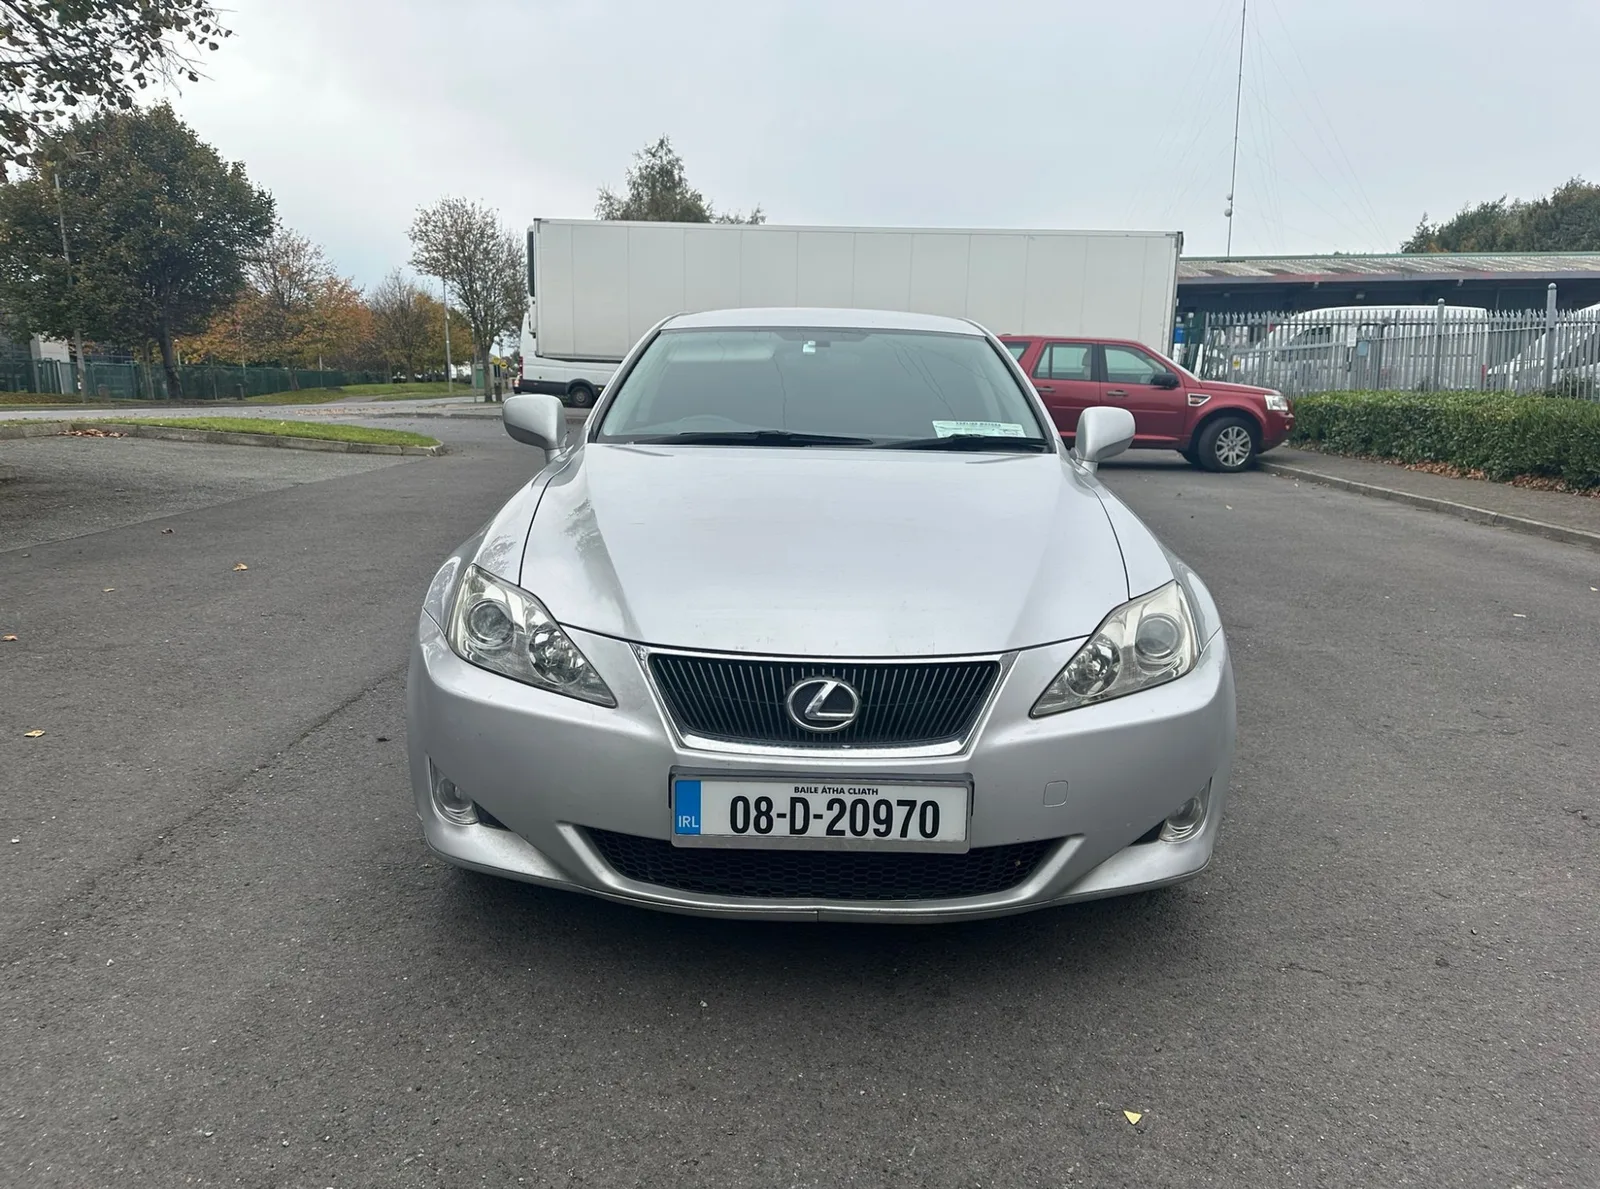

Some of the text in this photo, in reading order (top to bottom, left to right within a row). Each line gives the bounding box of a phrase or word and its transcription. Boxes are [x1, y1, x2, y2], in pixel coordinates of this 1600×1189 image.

[794, 785, 879, 796] BAILE ÁTHA CLIATH
[678, 815, 699, 828] IRL
[729, 795, 940, 839] 08-D-20970
